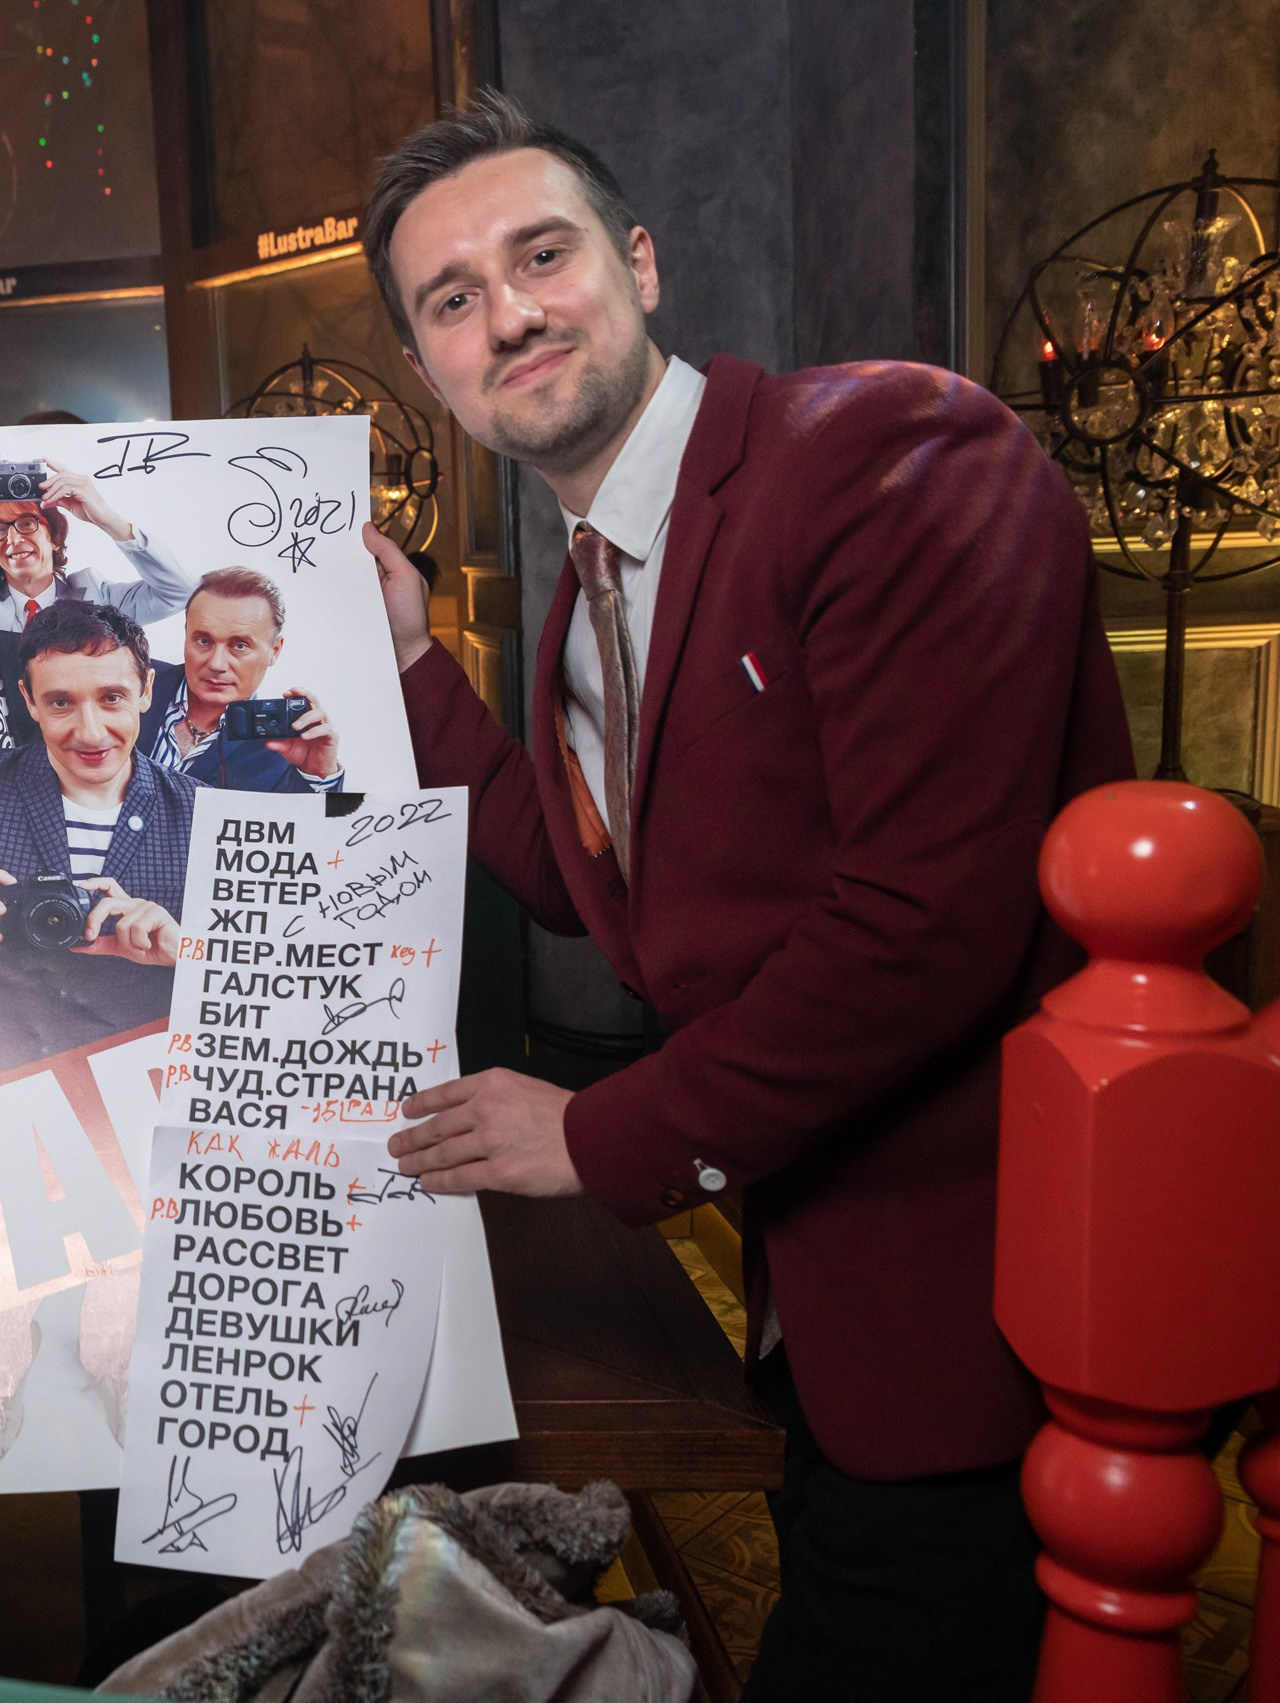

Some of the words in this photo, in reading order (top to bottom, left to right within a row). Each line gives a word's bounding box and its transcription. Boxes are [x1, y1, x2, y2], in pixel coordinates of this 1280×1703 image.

[258, 217, 358, 259] #LustraBar
[216, 819, 296, 845] ДВМ
[345, 799, 452, 847] 2022
[215, 849, 319, 876] МОДА
[212, 878, 322, 906] ВЕТЕР
[207, 908, 268, 935] ЖП
[206, 938, 383, 968] ПЕР.МЕСТ
[202, 969, 362, 999] ГАЛСТУК
[199, 1001, 270, 1030] БИТ
[194, 1032, 423, 1070] ЗЕМ.ДОЖДЬ
[192, 1065, 418, 1102] ЧУД.СТРАНА
[188, 1098, 288, 1130] ВАСЯ
[179, 1162, 336, 1201] КОРОЛЬ
[174, 1198, 344, 1237] ЛЮБОВЬ
[173, 1234, 349, 1275] РАССВЕТ
[167, 1271, 325, 1310] ДОРОГА
[165, 1306, 360, 1347] ДЕВУШКИ
[162, 1343, 323, 1383] ЛЕНРОК
[159, 1380, 288, 1417] ОТЕЛЬ
[157, 1416, 290, 1462] ГОРОД
